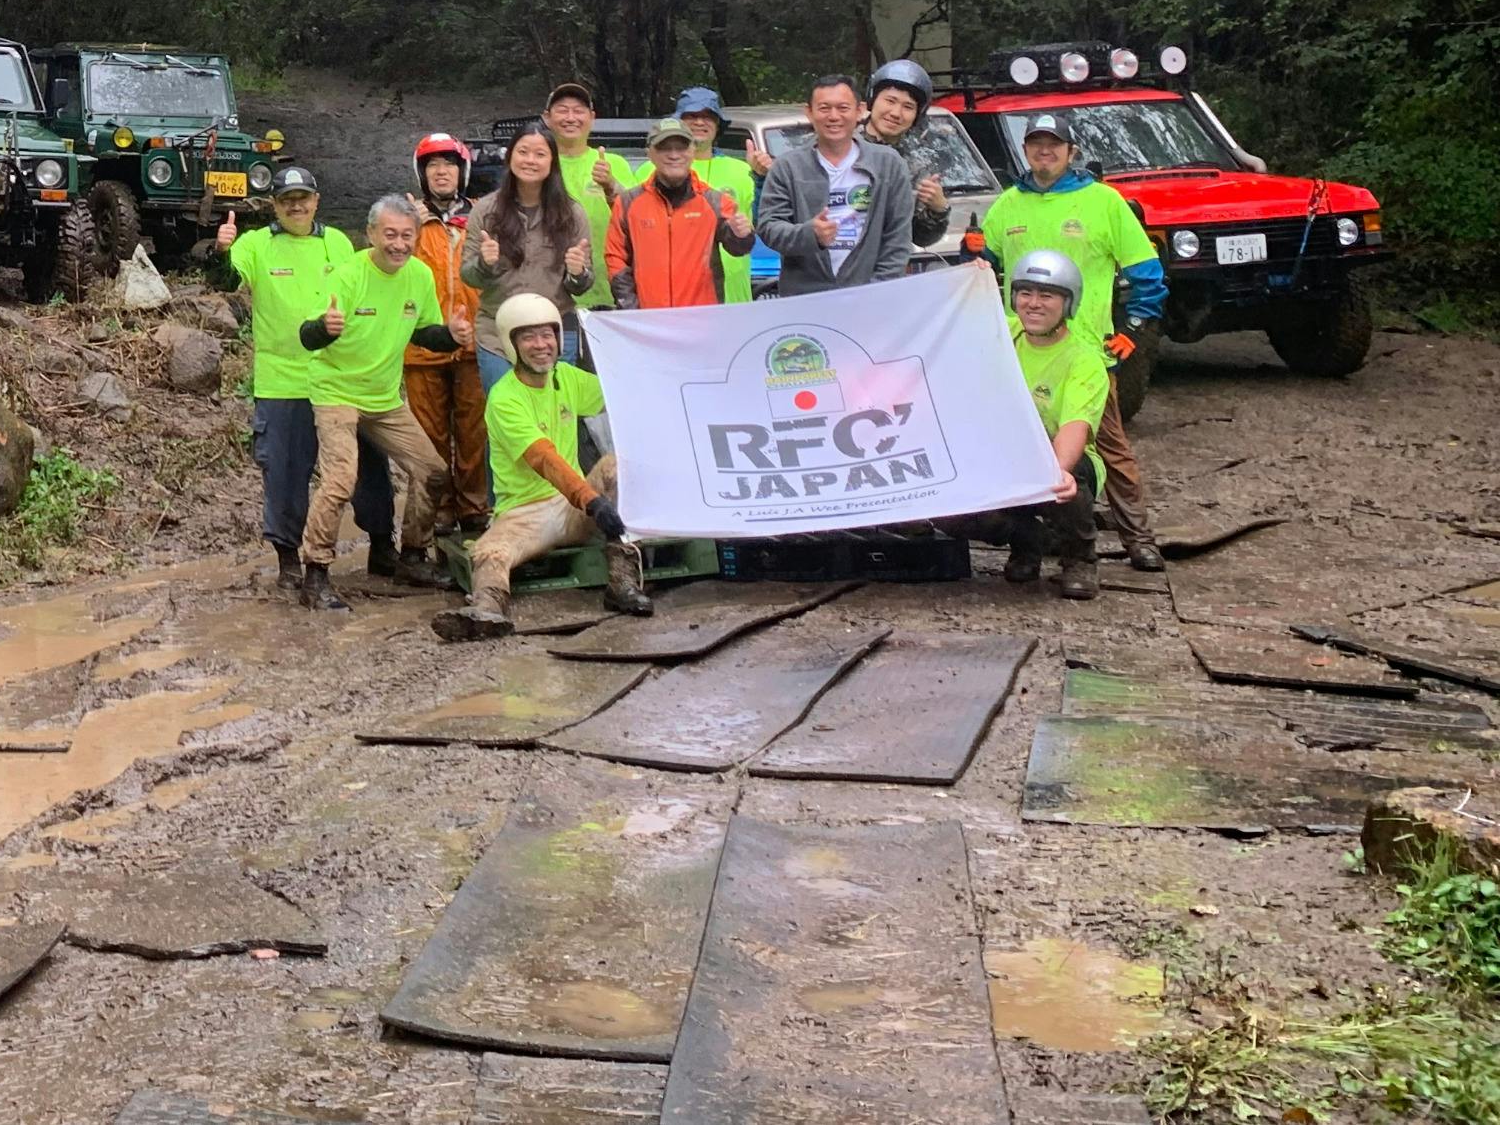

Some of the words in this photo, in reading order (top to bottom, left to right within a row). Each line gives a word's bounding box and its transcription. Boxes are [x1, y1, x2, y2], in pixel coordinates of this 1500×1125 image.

[1228, 246, 1264, 262] 78-11
[718, 453, 934, 501] JAPAN
[748, 508, 779, 517] Luis
[810, 504, 842, 513] Wee
[846, 489, 940, 510] Presentation
